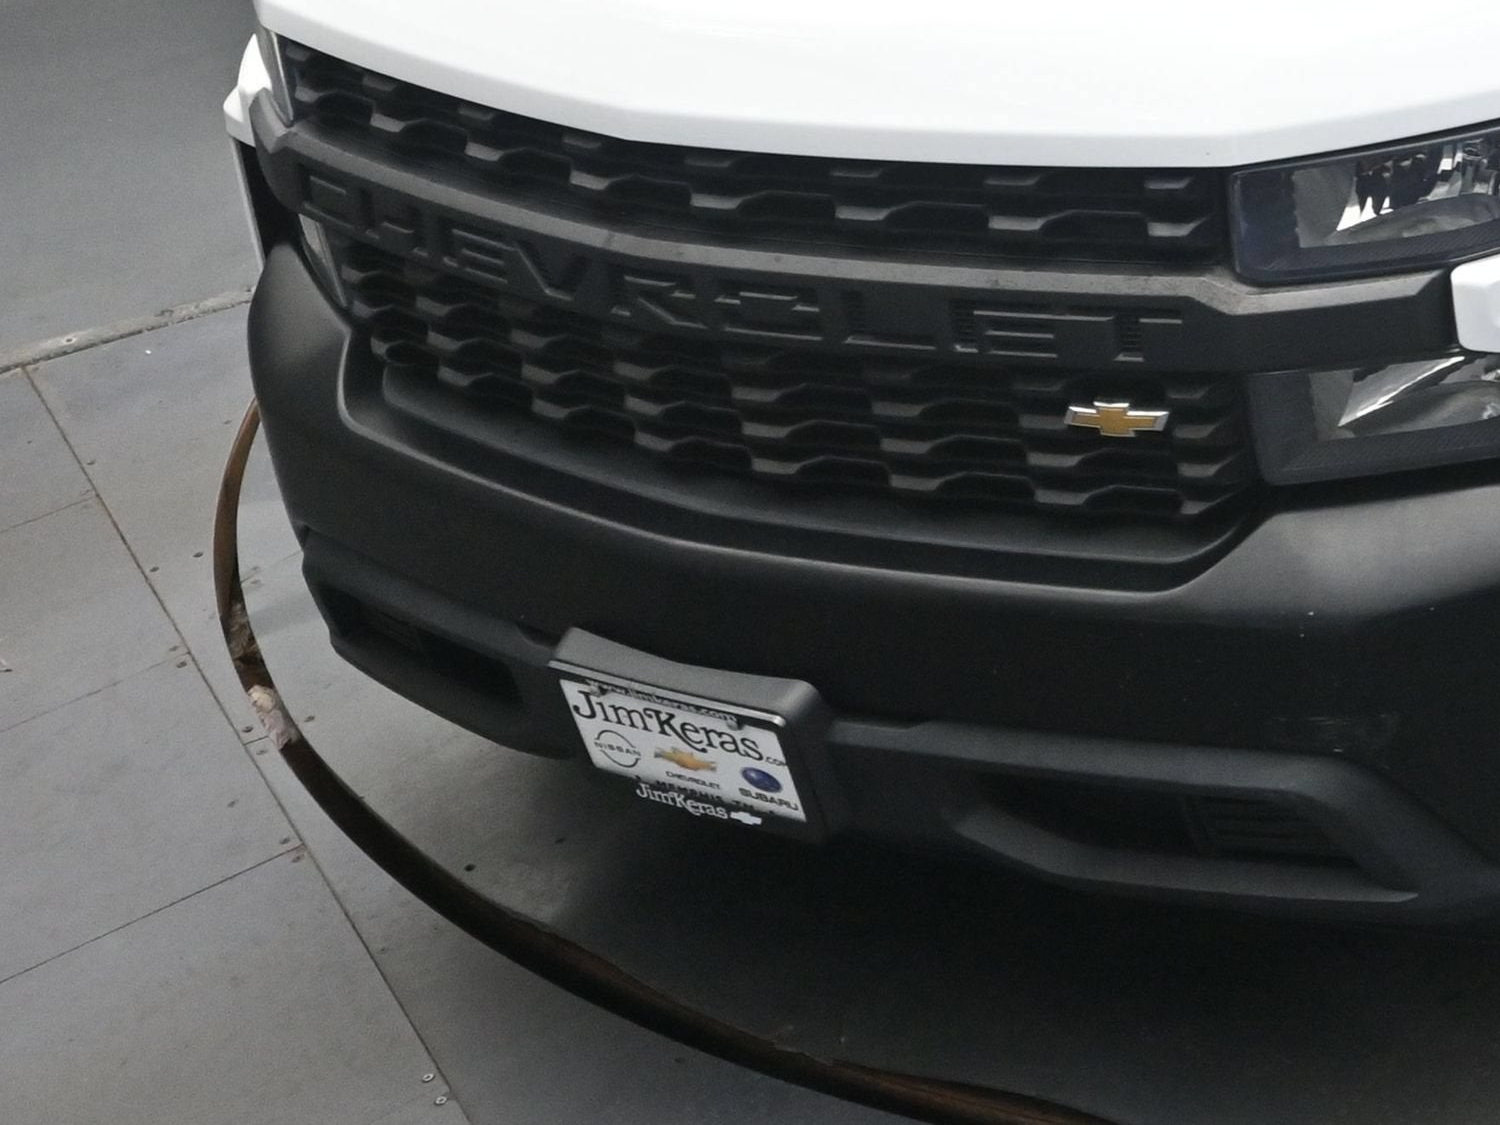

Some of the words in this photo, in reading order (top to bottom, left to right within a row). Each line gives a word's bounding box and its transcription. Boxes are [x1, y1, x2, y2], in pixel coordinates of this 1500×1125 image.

[295, 159, 1187, 364] CHEVROLET
[594, 741, 641, 757] NISSAN
[664, 771, 721, 790] CHEVROLET
[636, 782, 729, 820] JimKeras
[738, 787, 799, 811] SUBARU
